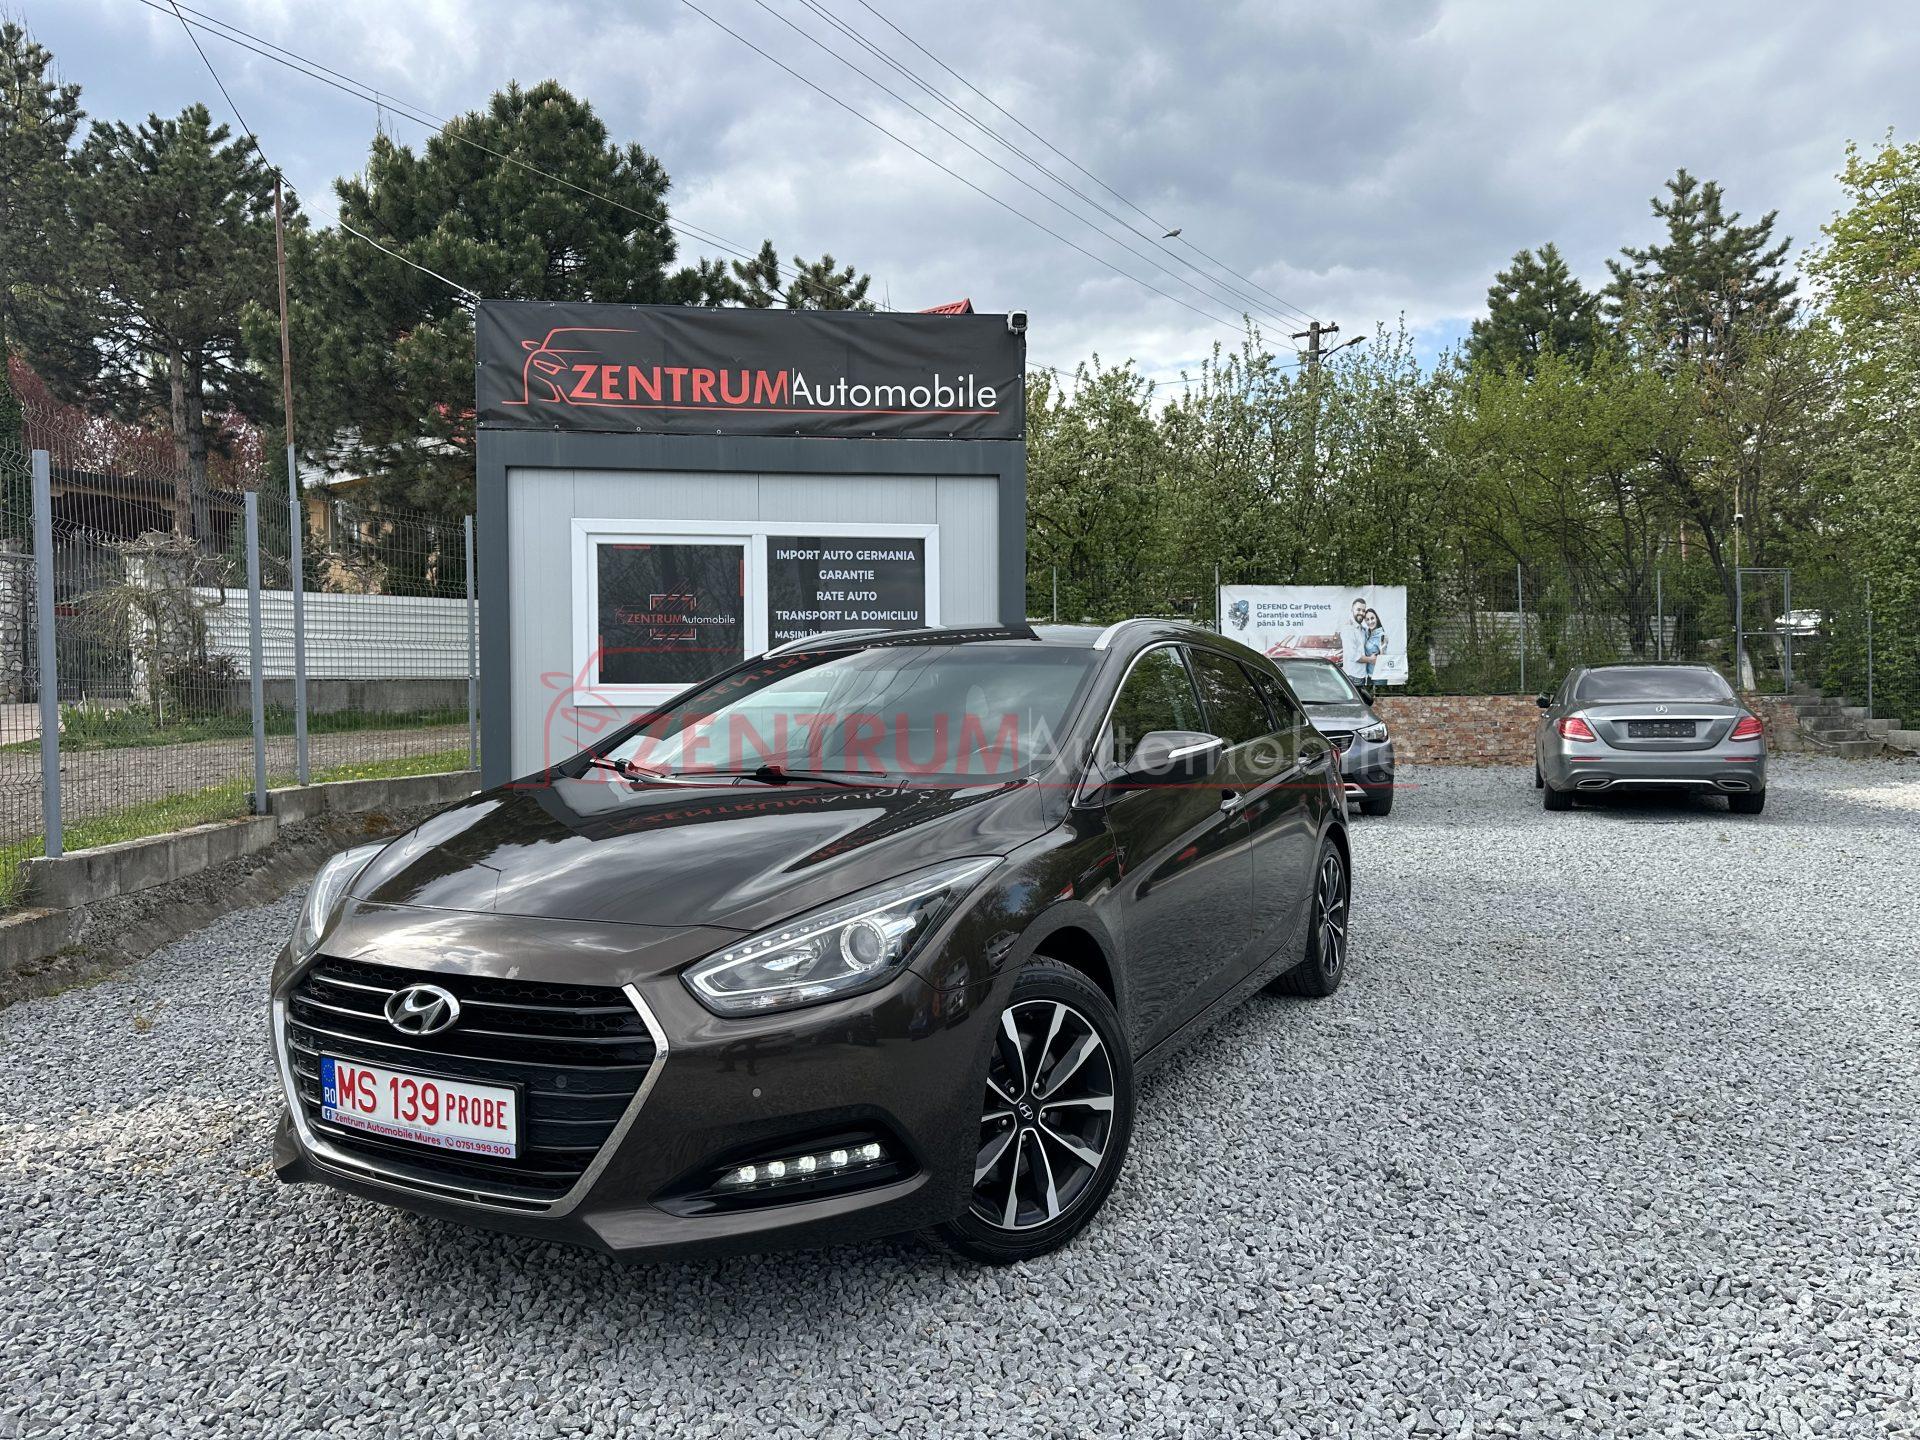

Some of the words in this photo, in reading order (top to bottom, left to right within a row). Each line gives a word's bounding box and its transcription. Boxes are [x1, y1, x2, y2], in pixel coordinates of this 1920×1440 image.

[570, 363, 788, 405] ZENTRUM
[793, 371, 998, 409] Automobile
[776, 550, 820, 561] IMPORT
[822, 550, 854, 561] AUTO
[856, 550, 915, 561] GERMANIA
[818, 569, 875, 583] GARANȚIE
[816, 591, 845, 601] RATE
[847, 591, 877, 601] AUTO
[627, 613, 683, 625] ZENTRUM
[682, 613, 736, 625] Automobile
[776, 610, 842, 621] TRANSPORT
[844, 610, 859, 621] LA
[861, 611, 918, 621] DOMICILIU
[1277, 619, 1285, 627] la
[1292, 619, 1304, 627] ani
[324, 1086, 336, 1104] RO
[337, 1065, 377, 1113] MS
[389, 1076, 439, 1126] 139
[445, 1093, 507, 1131] PROBE
[335, 1112, 366, 1128] Zentrum
[367, 1121, 413, 1139] Automobile
[414, 1131, 441, 1145] Mures
[455, 1140, 511, 1156] 0751.999.900
